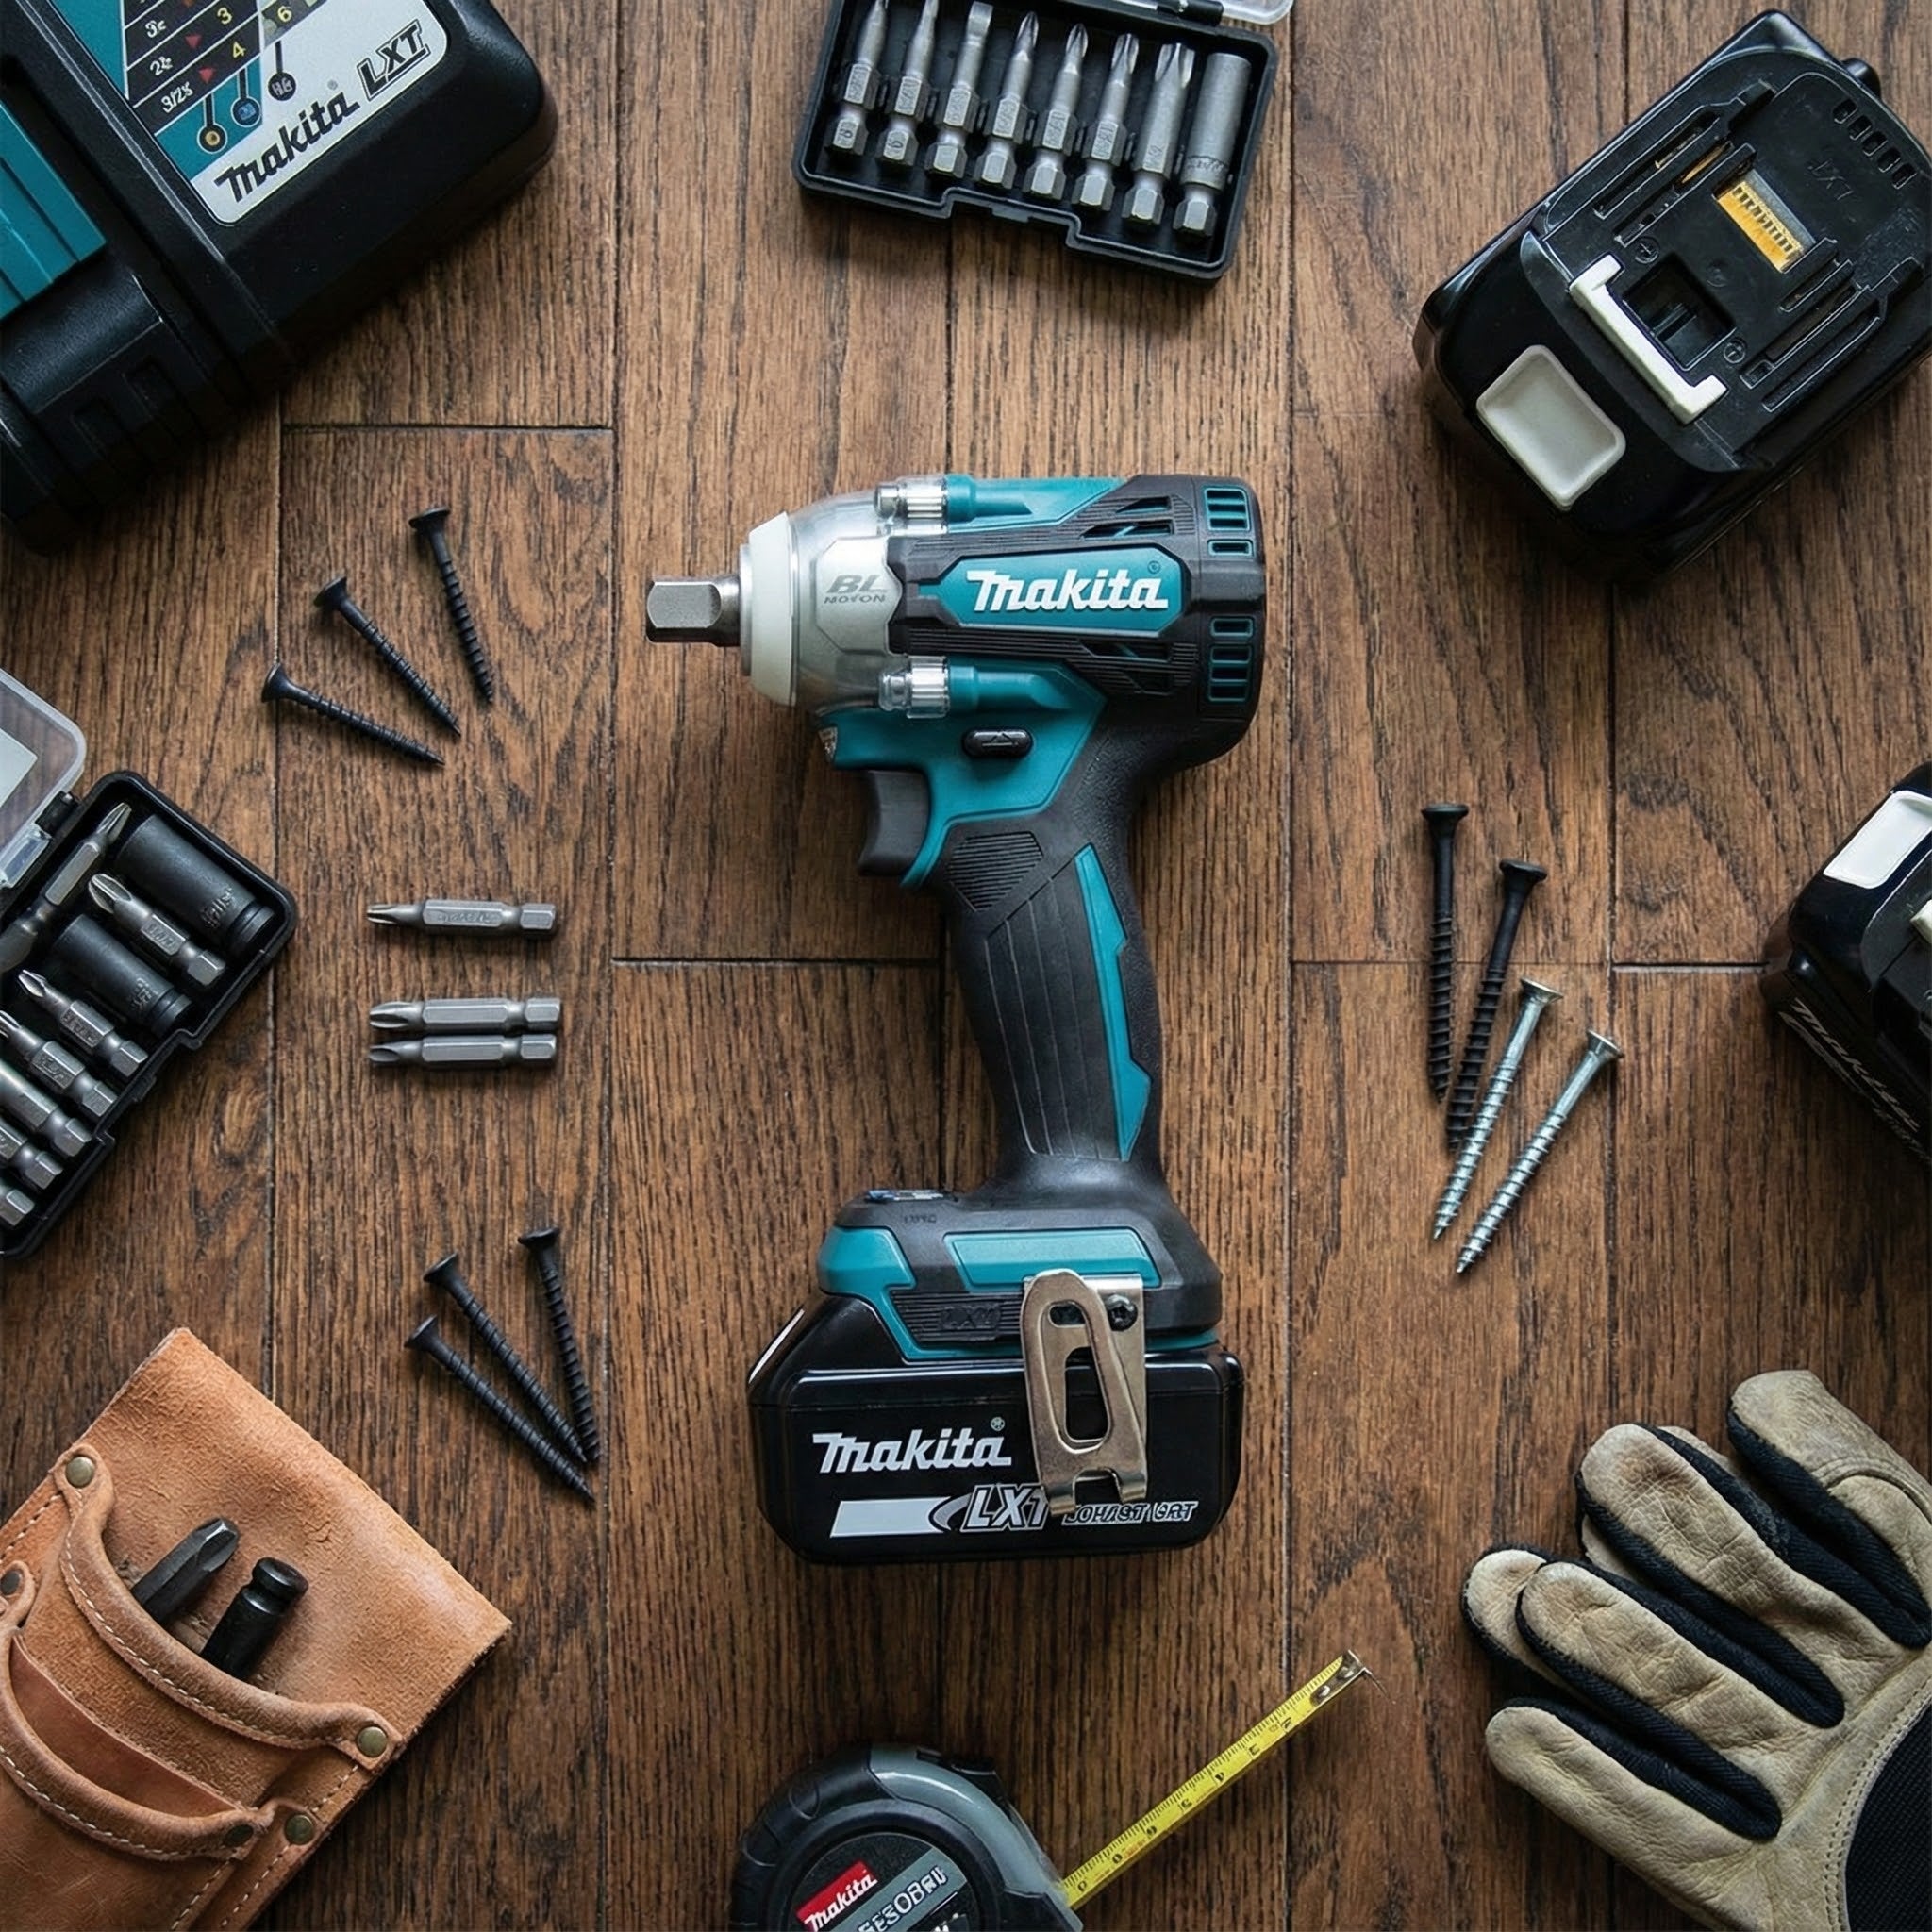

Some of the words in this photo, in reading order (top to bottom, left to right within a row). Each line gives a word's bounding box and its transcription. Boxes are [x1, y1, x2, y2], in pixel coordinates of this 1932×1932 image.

[216, 7, 233, 25] 3
[232, 41, 246, 58] 4
[277, 5, 292, 23] 6
[214, 92, 360, 203] Makita
[357, 18, 431, 102] LXT
[826, 575, 889, 593] BL
[966, 569, 1169, 612] Makita
[812, 1428, 1012, 1474] Makita
[804, 1874, 878, 1932] Makita
